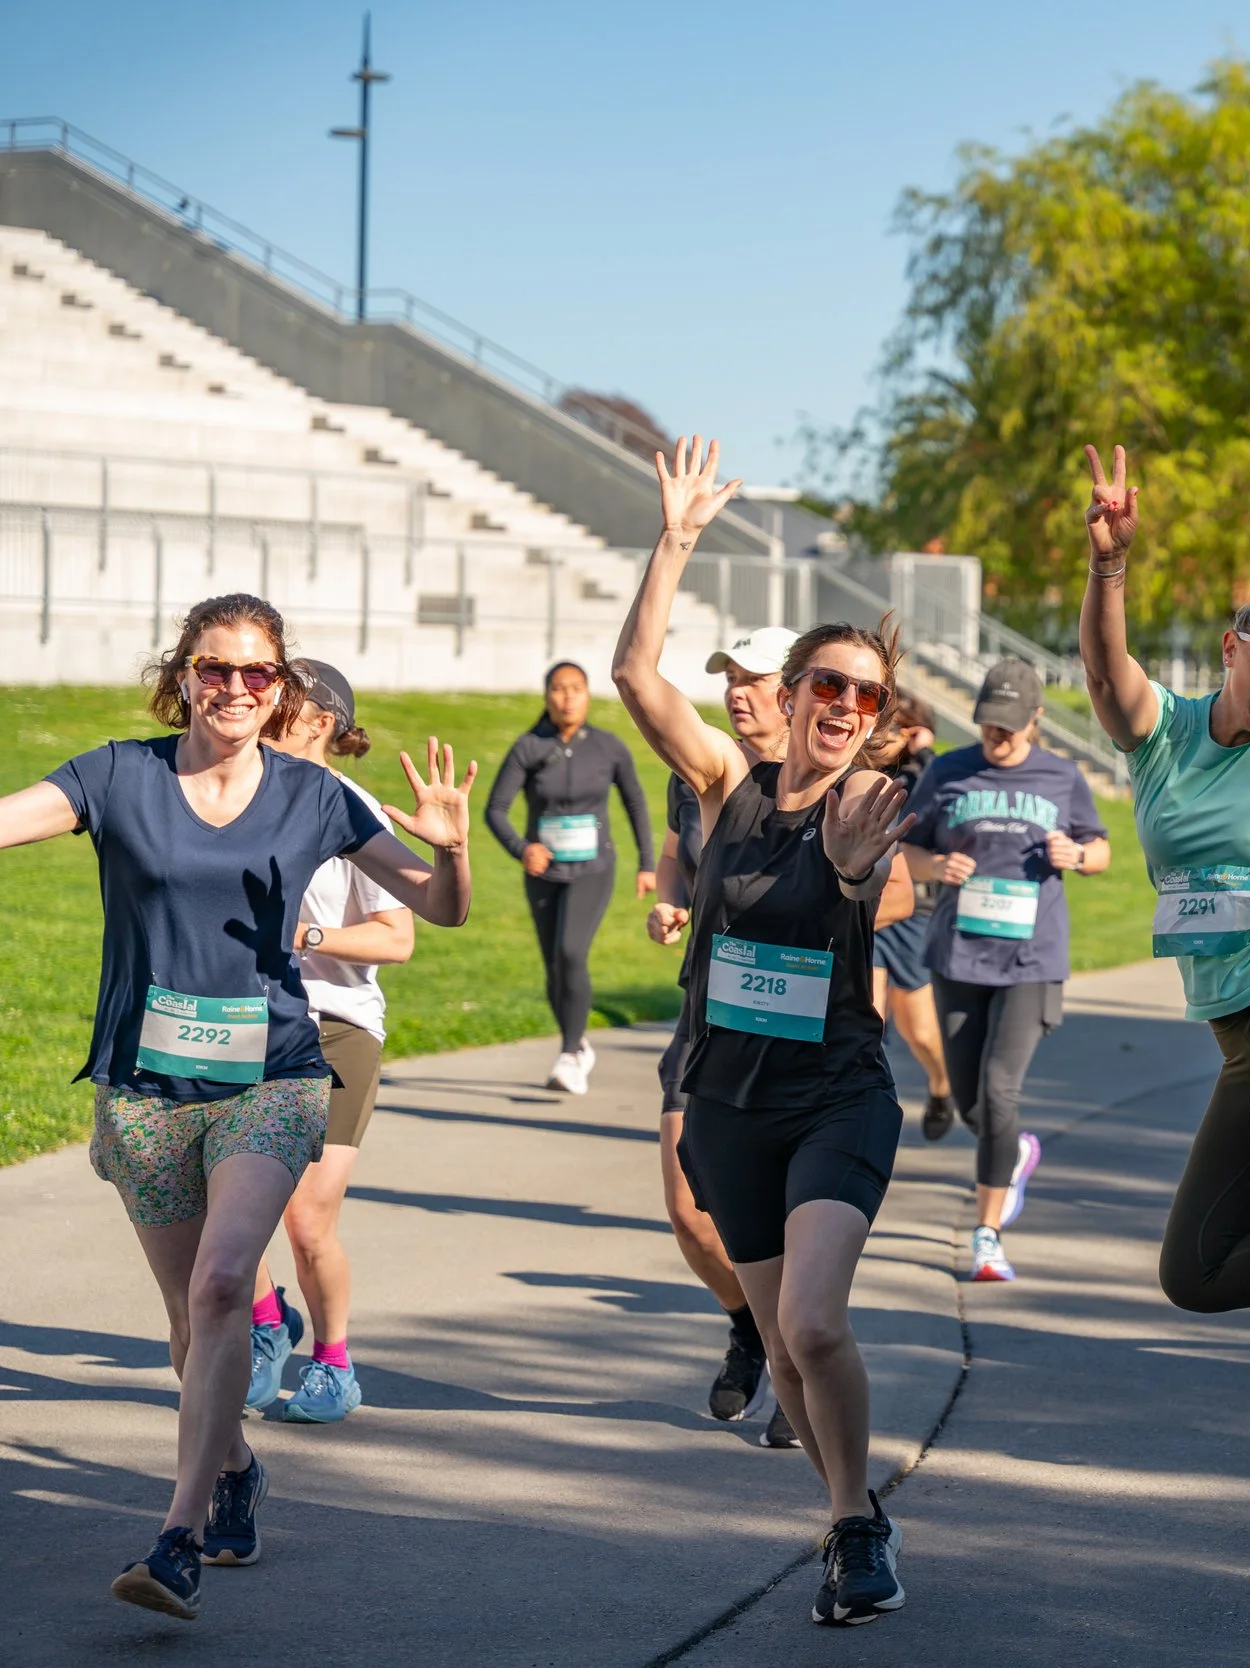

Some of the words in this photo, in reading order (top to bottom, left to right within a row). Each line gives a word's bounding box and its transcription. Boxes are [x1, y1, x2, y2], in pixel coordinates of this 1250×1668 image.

[1178, 897, 1216, 916] 2291
[740, 973, 787, 996] 2218
[157, 995, 198, 1011] Coastal
[177, 1024, 232, 1045] 2292
